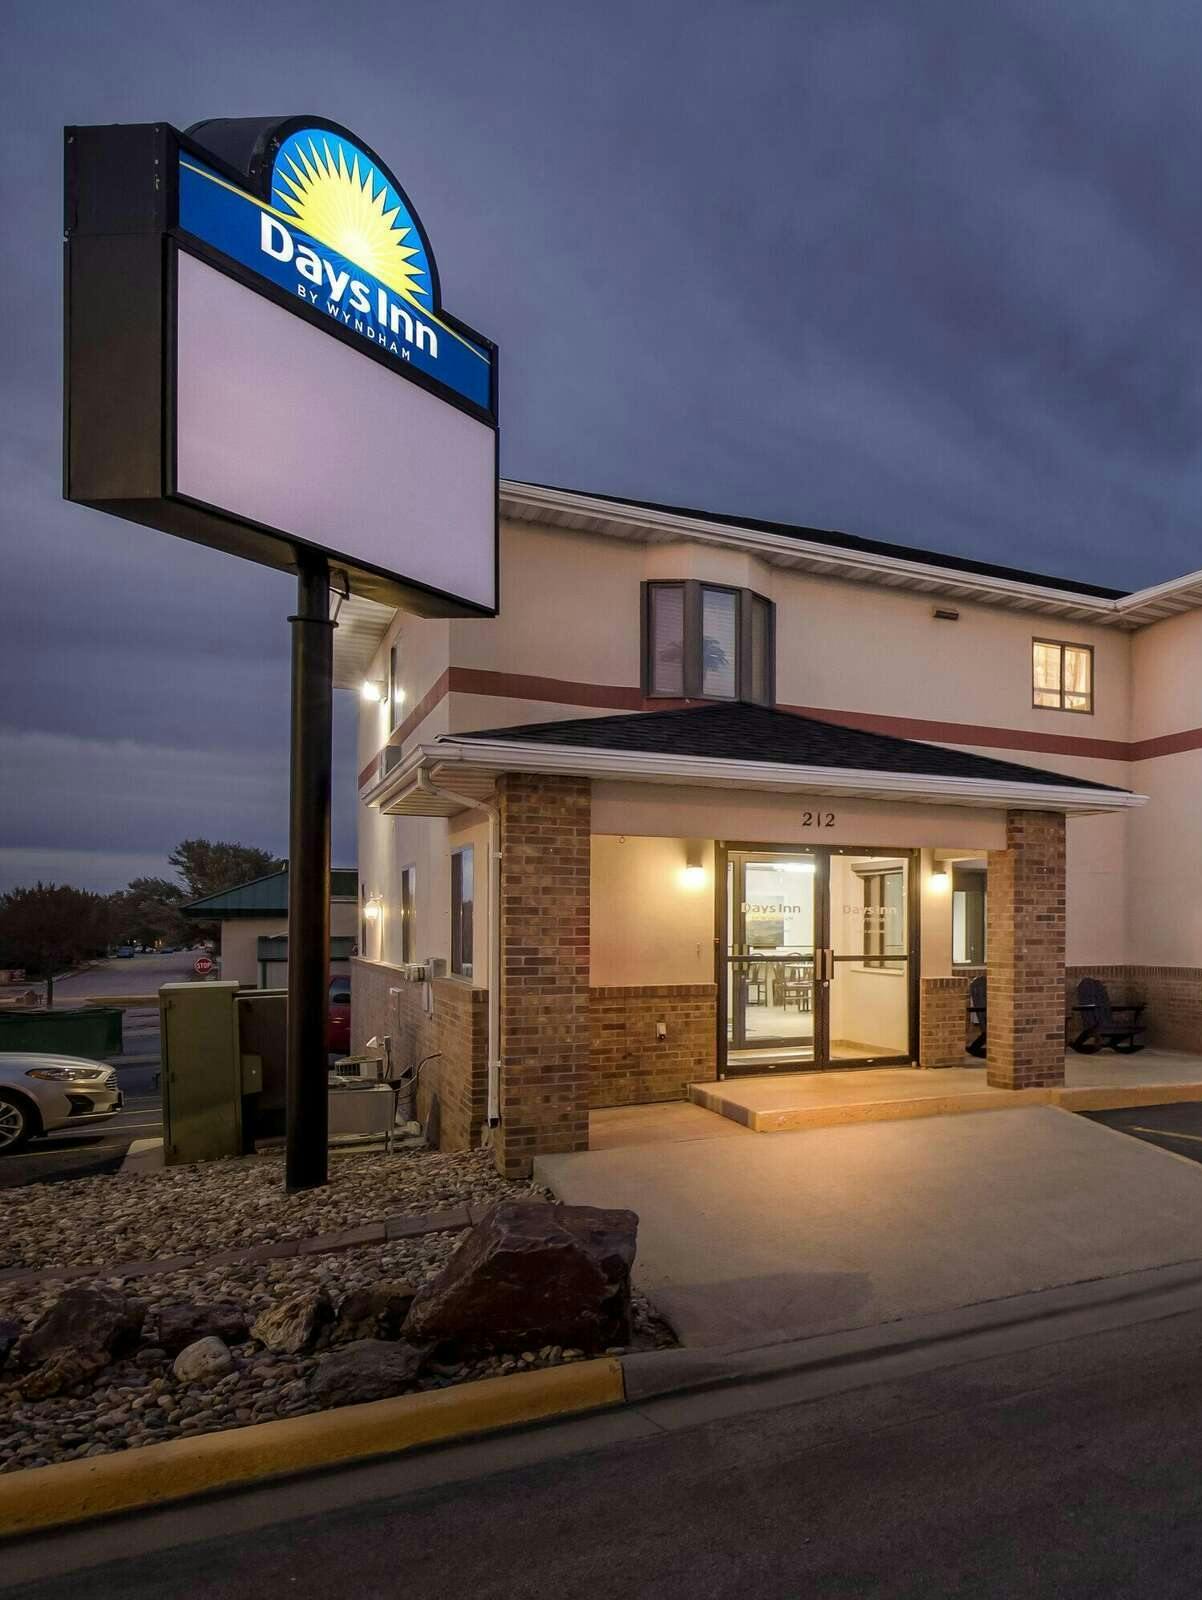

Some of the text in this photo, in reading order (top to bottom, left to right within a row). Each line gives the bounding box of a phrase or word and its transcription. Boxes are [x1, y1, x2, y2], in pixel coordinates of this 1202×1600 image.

[260, 211, 438, 359] Days Inn
[297, 284, 410, 361] BY WYNDHAM
[802, 811, 835, 828] 212
[741, 902, 801, 913] Days Inn
[843, 904, 873, 915] Days
